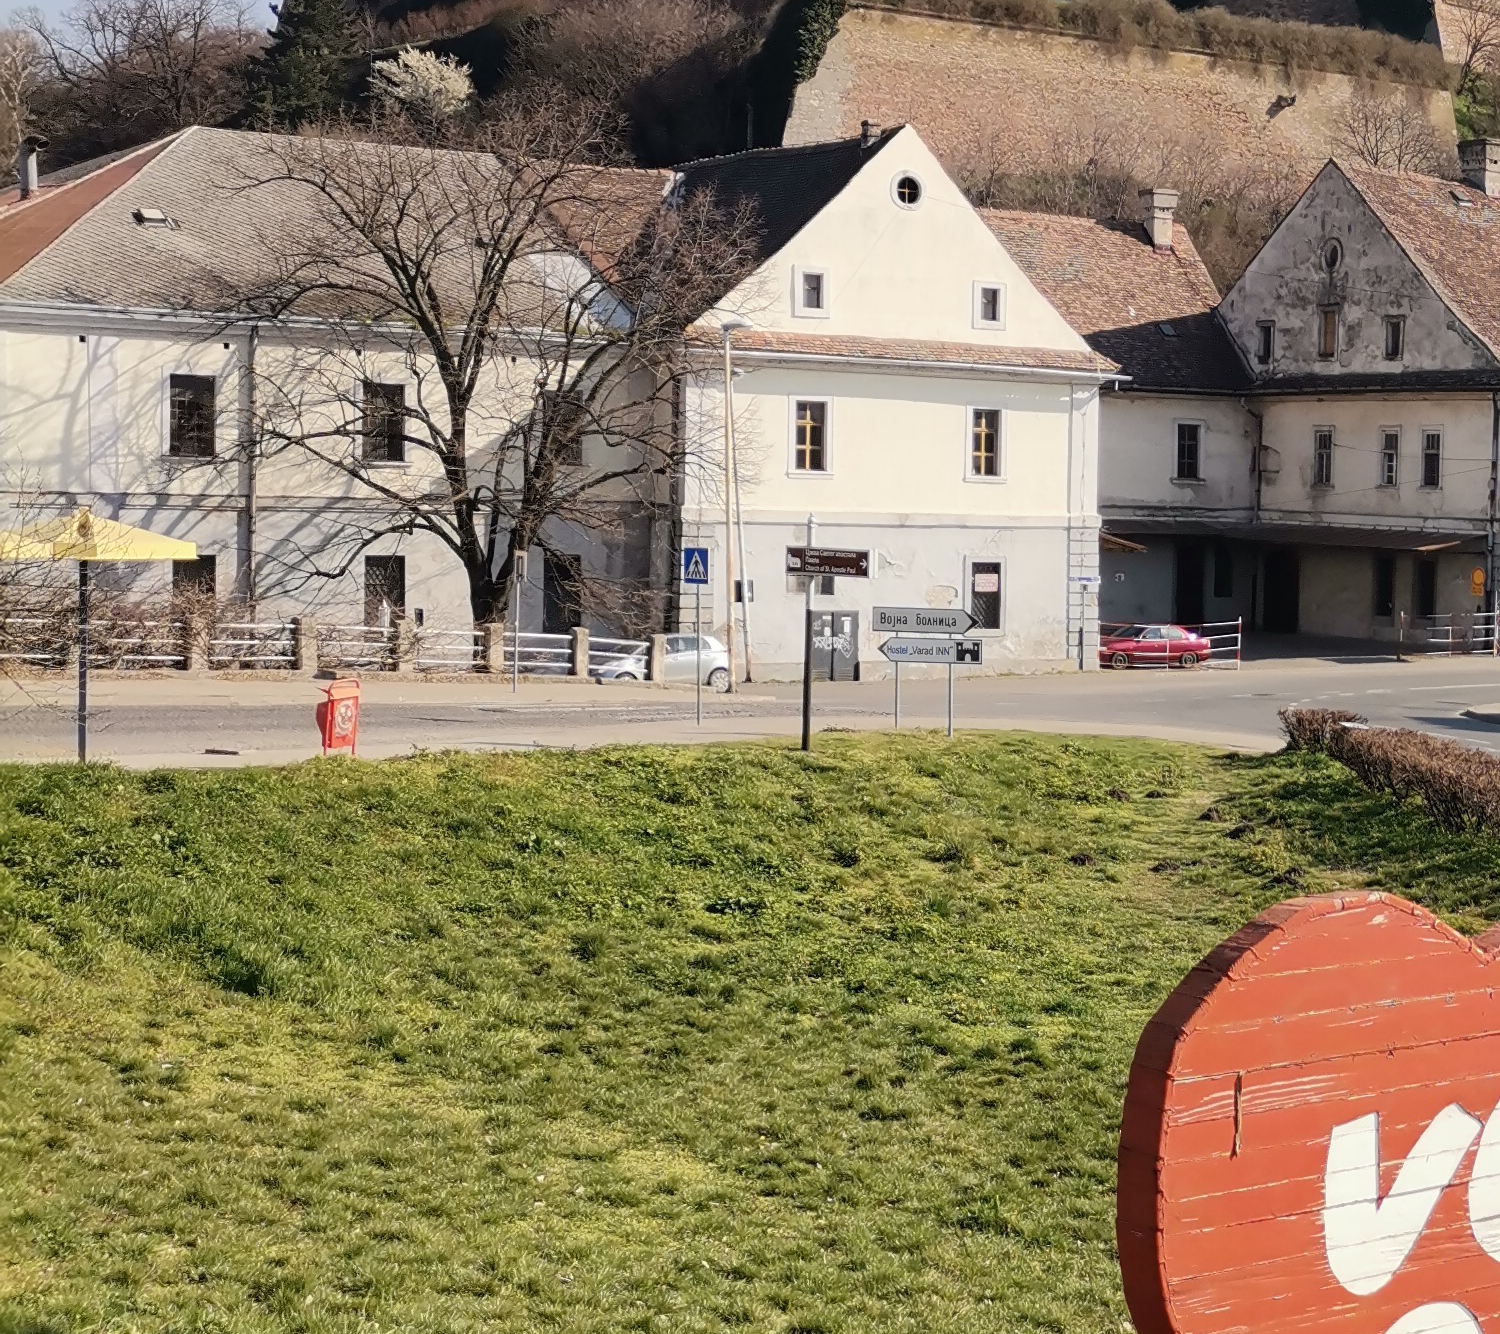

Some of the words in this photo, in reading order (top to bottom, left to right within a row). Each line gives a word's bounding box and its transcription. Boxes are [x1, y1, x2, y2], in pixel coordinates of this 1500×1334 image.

[880, 612, 908, 627] Војна
[916, 613, 957, 628] болница
[887, 645, 908, 655] Hostel
